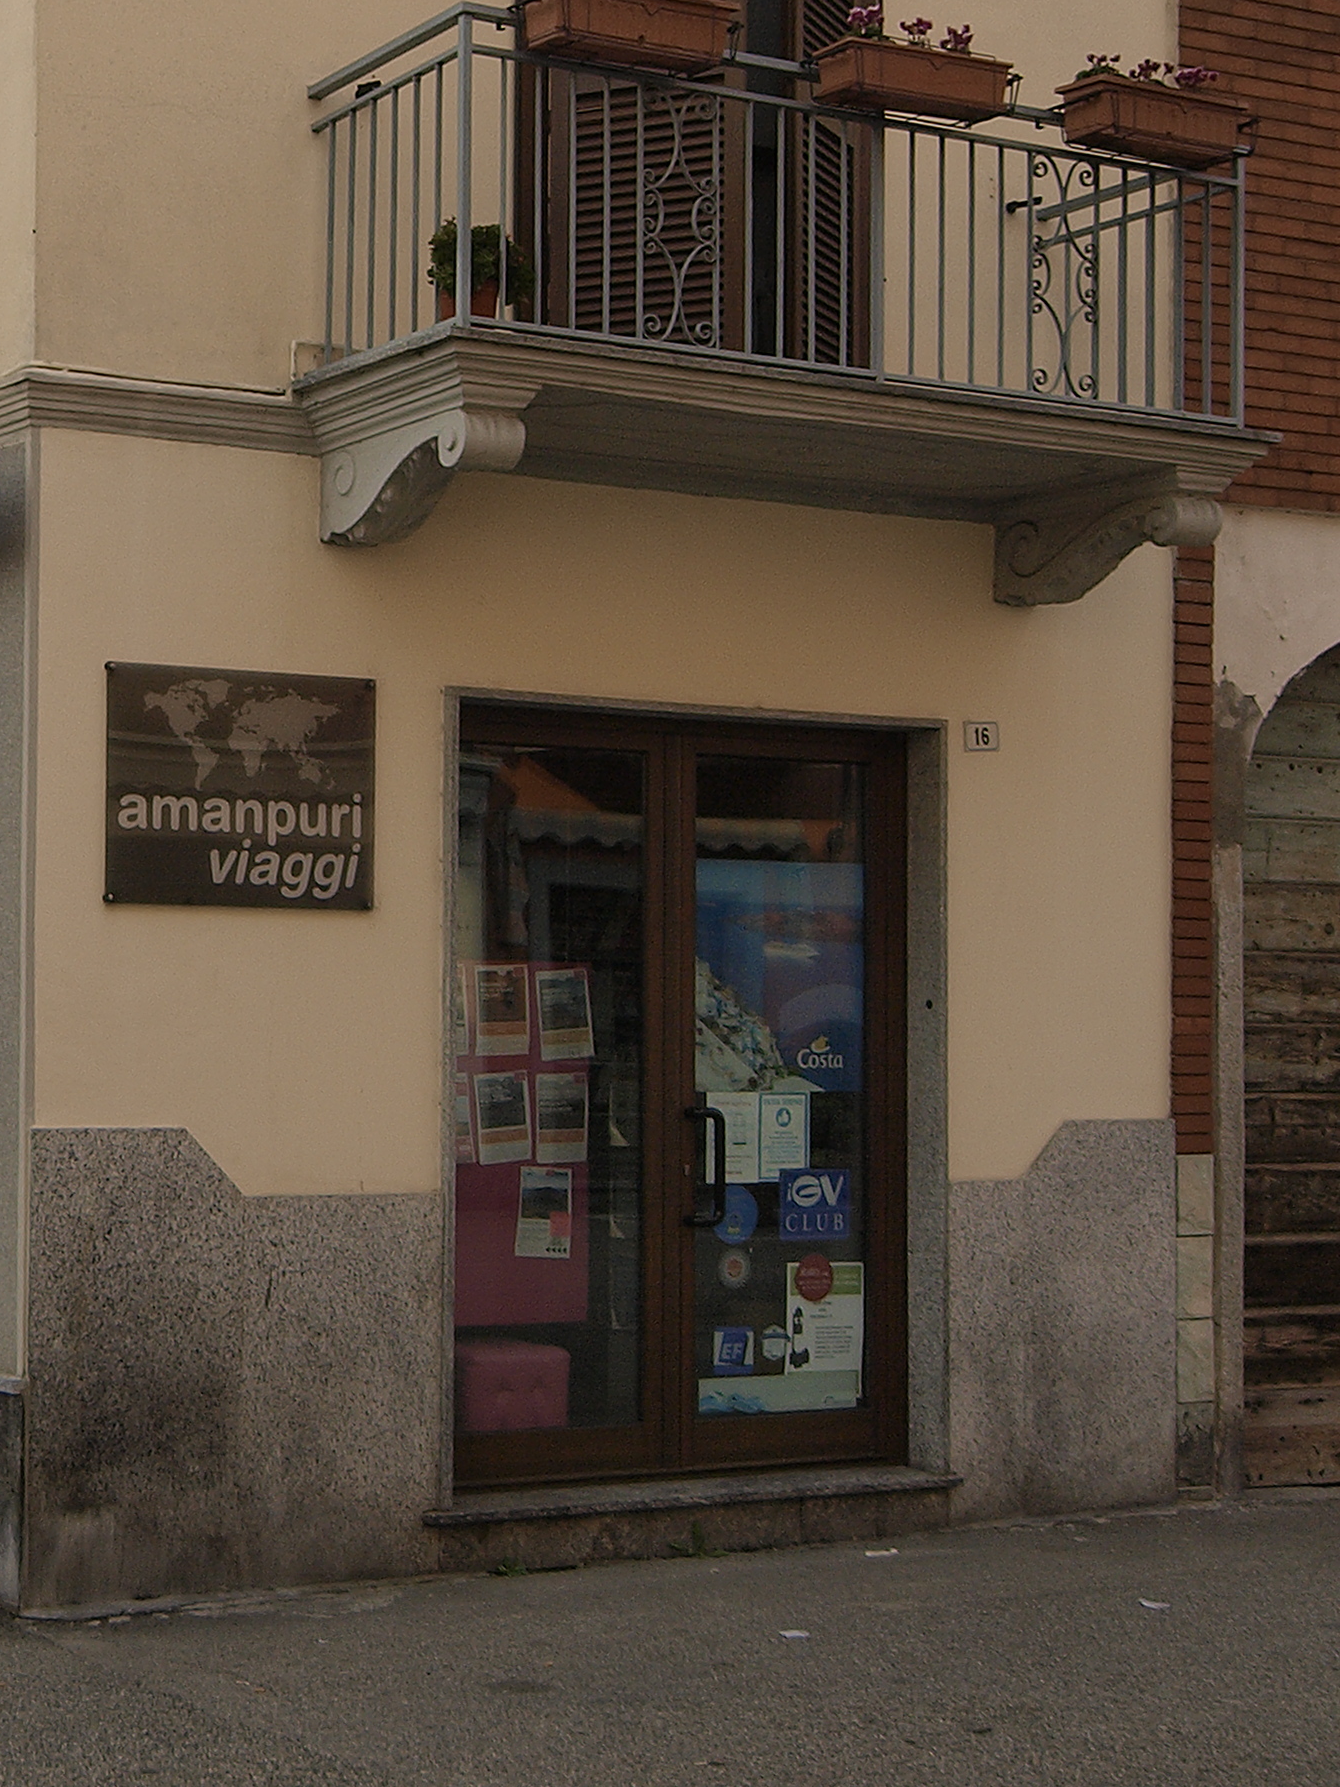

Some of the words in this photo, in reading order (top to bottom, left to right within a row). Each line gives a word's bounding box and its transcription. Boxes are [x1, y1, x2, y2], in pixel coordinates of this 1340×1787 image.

[975, 727, 990, 746] 16
[118, 792, 362, 846] amanpuri
[210, 839, 361, 900] viaggi
[796, 1048, 844, 1070] Costa
[785, 1213, 845, 1233] CLUB
[721, 1342, 744, 1360] EF
